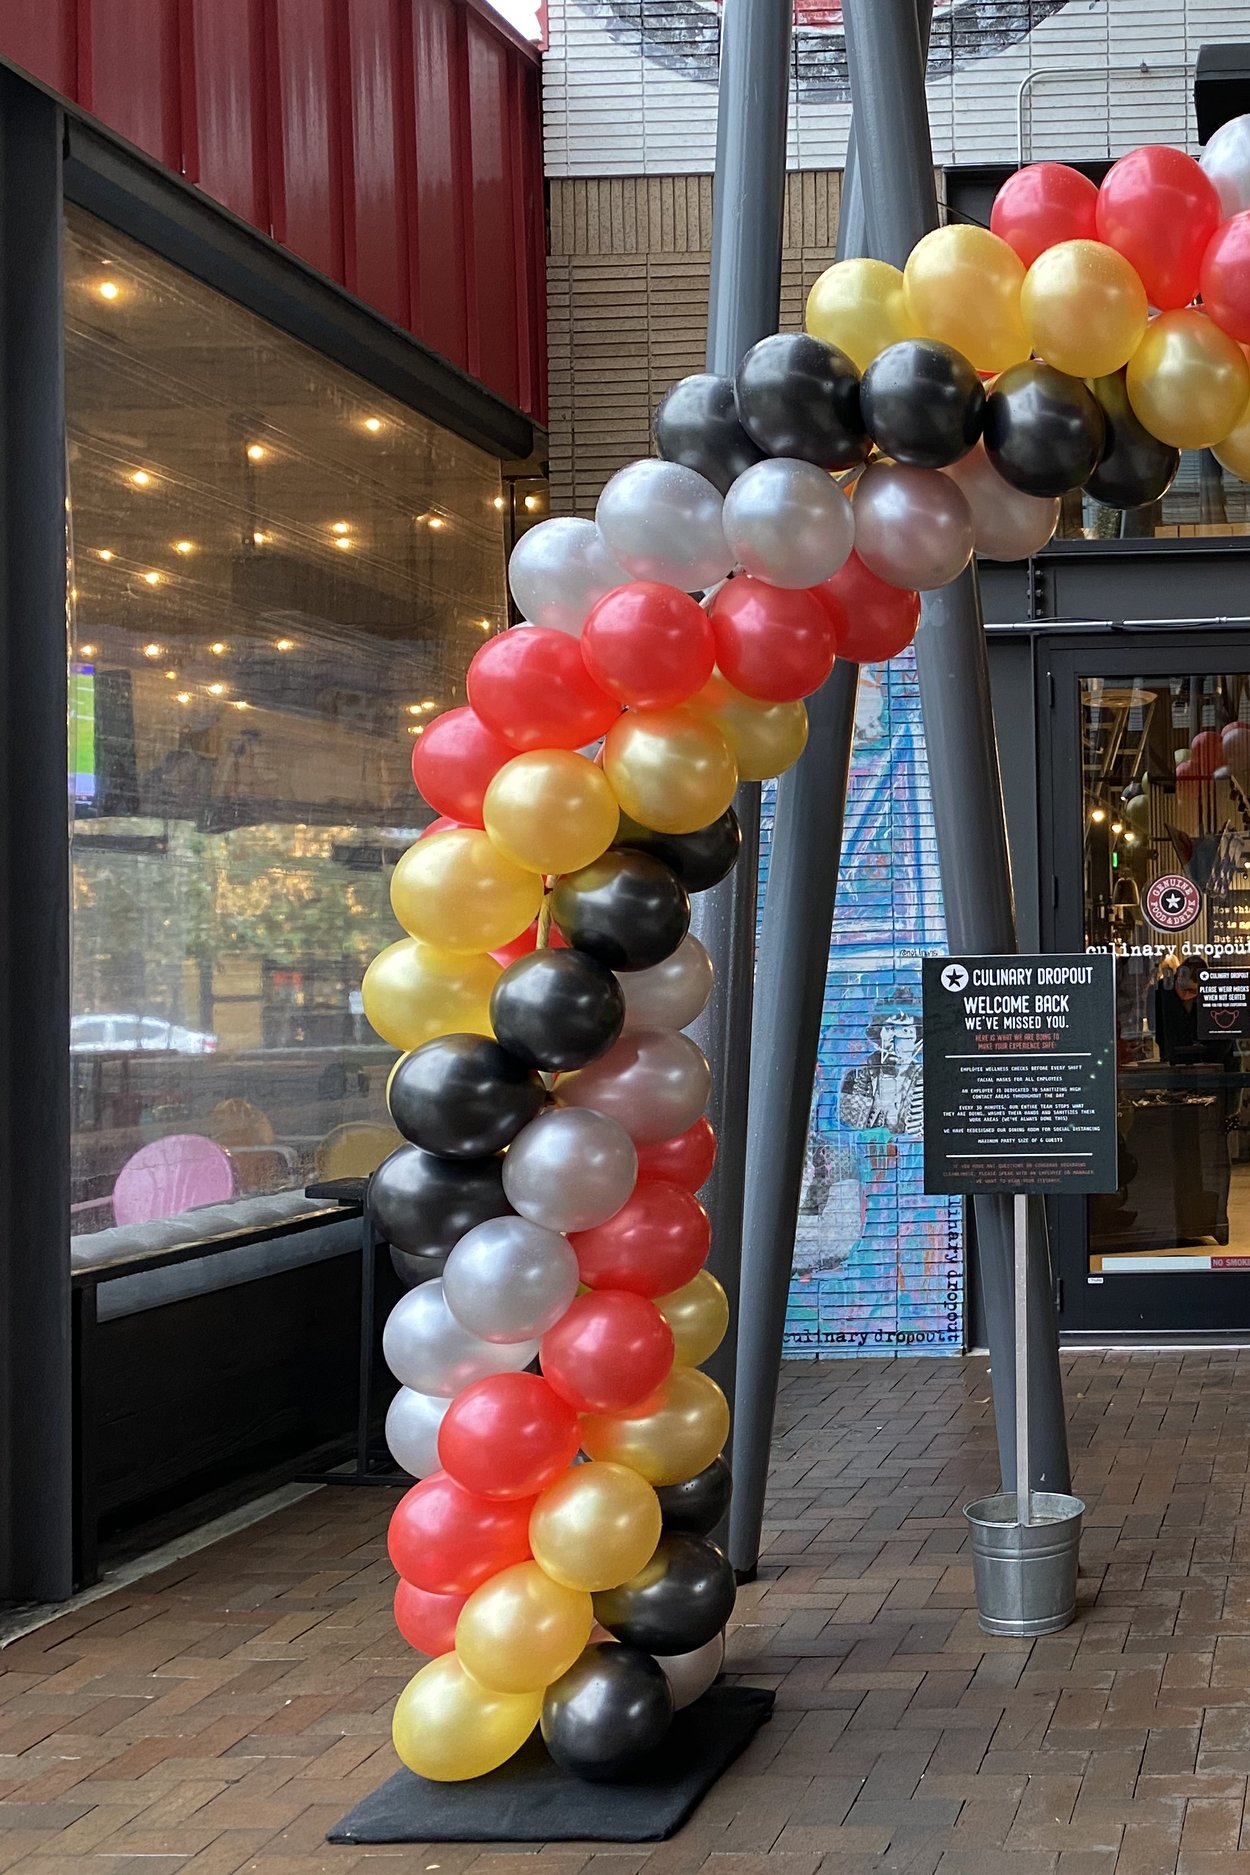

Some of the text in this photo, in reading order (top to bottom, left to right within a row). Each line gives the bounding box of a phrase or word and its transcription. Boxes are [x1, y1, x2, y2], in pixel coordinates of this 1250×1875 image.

[1152, 878, 1194, 896] GENUINE
[1150, 901, 1166, 922] FOOD
[1174, 899, 1196, 925] DRINK
[1085, 942, 1178, 959] culinary
[972, 966, 1093, 987] CULINARY DROPOUT
[963, 994, 1070, 1014] WELCOME BACK
[964, 1015, 1069, 1030] WE'VE MISSED YOU.
[945, 1194, 961, 1262] linary
[1212, 1258, 1224, 1267] NO
[783, 1329, 945, 1346] culinary dropout
